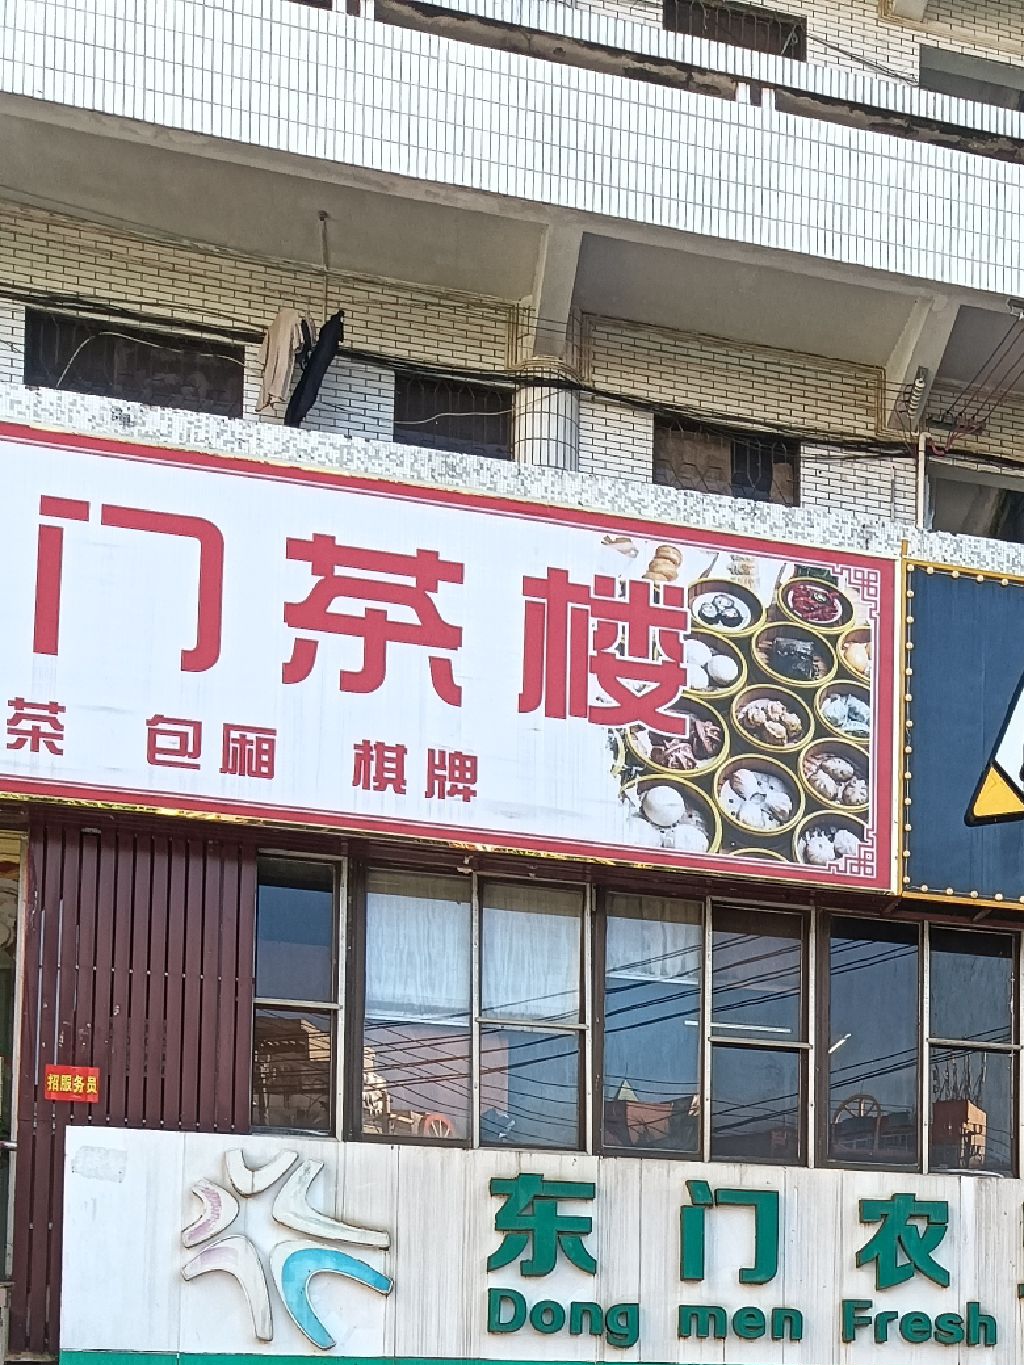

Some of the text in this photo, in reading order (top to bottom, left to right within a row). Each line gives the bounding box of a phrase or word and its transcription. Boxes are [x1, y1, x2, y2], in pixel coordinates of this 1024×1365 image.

[33, 494, 690, 736] 门茶楼
[6, 697, 479, 803] 茶 包厢 棋牌
[47, 1074, 97, 1093] 招服务员
[487, 1287, 640, 1349] Dong
[679, 1302, 802, 1341] men
[842, 1300, 997, 1347] Fresh
